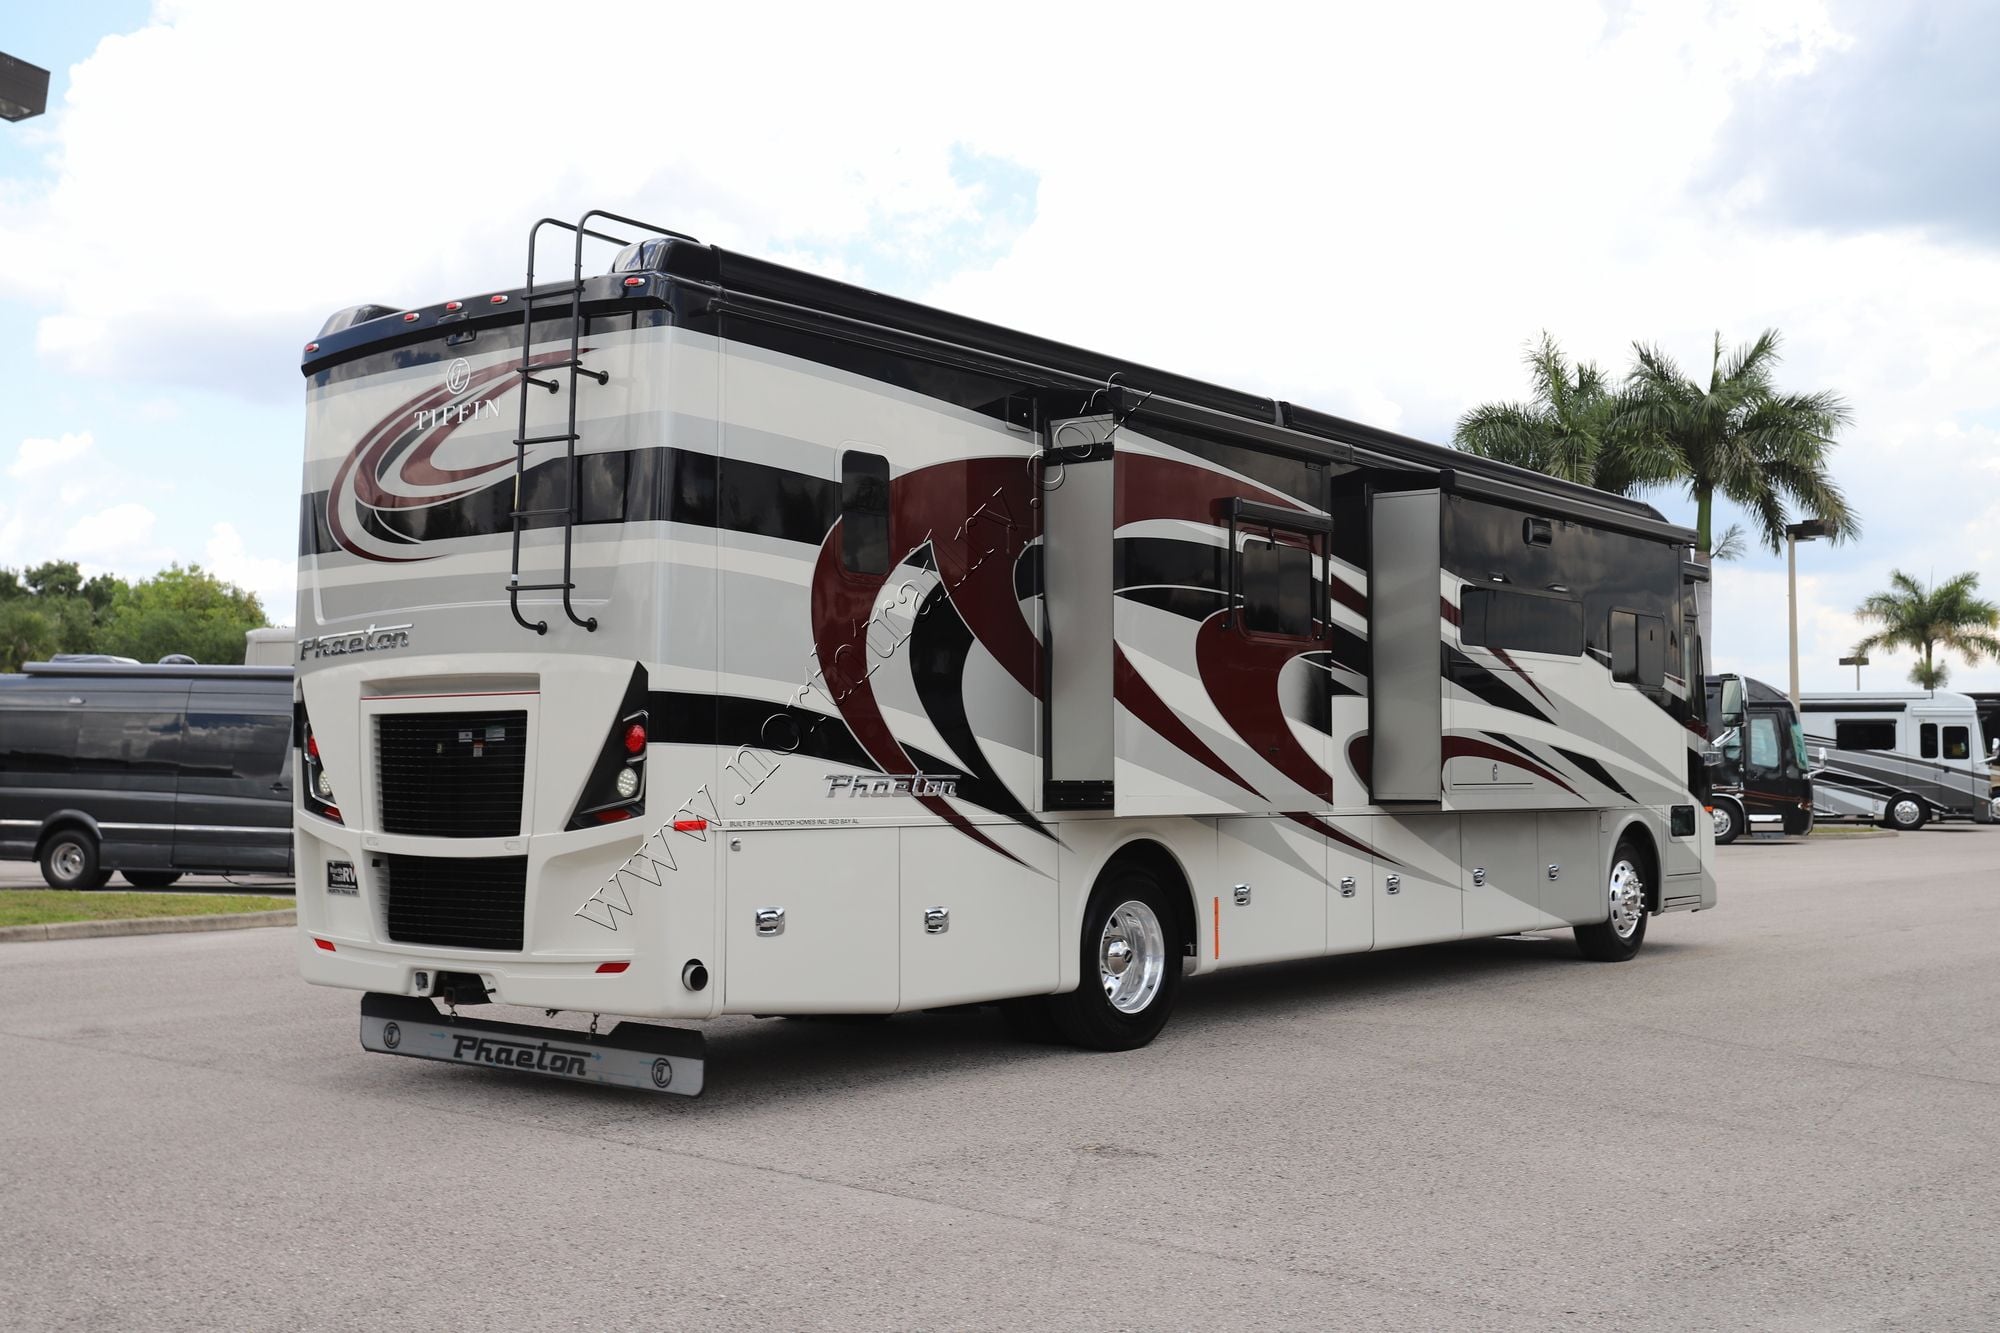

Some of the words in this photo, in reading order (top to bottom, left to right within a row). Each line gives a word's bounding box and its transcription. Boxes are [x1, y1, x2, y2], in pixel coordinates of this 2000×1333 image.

[414, 398, 500, 430] TIFFIN
[298, 624, 413, 661] Phaeton
[824, 770, 961, 798] Phaeton
[757, 819, 774, 827] TIFFIN
[343, 867, 358, 882] RV
[452, 1033, 593, 1076] Phaeton
